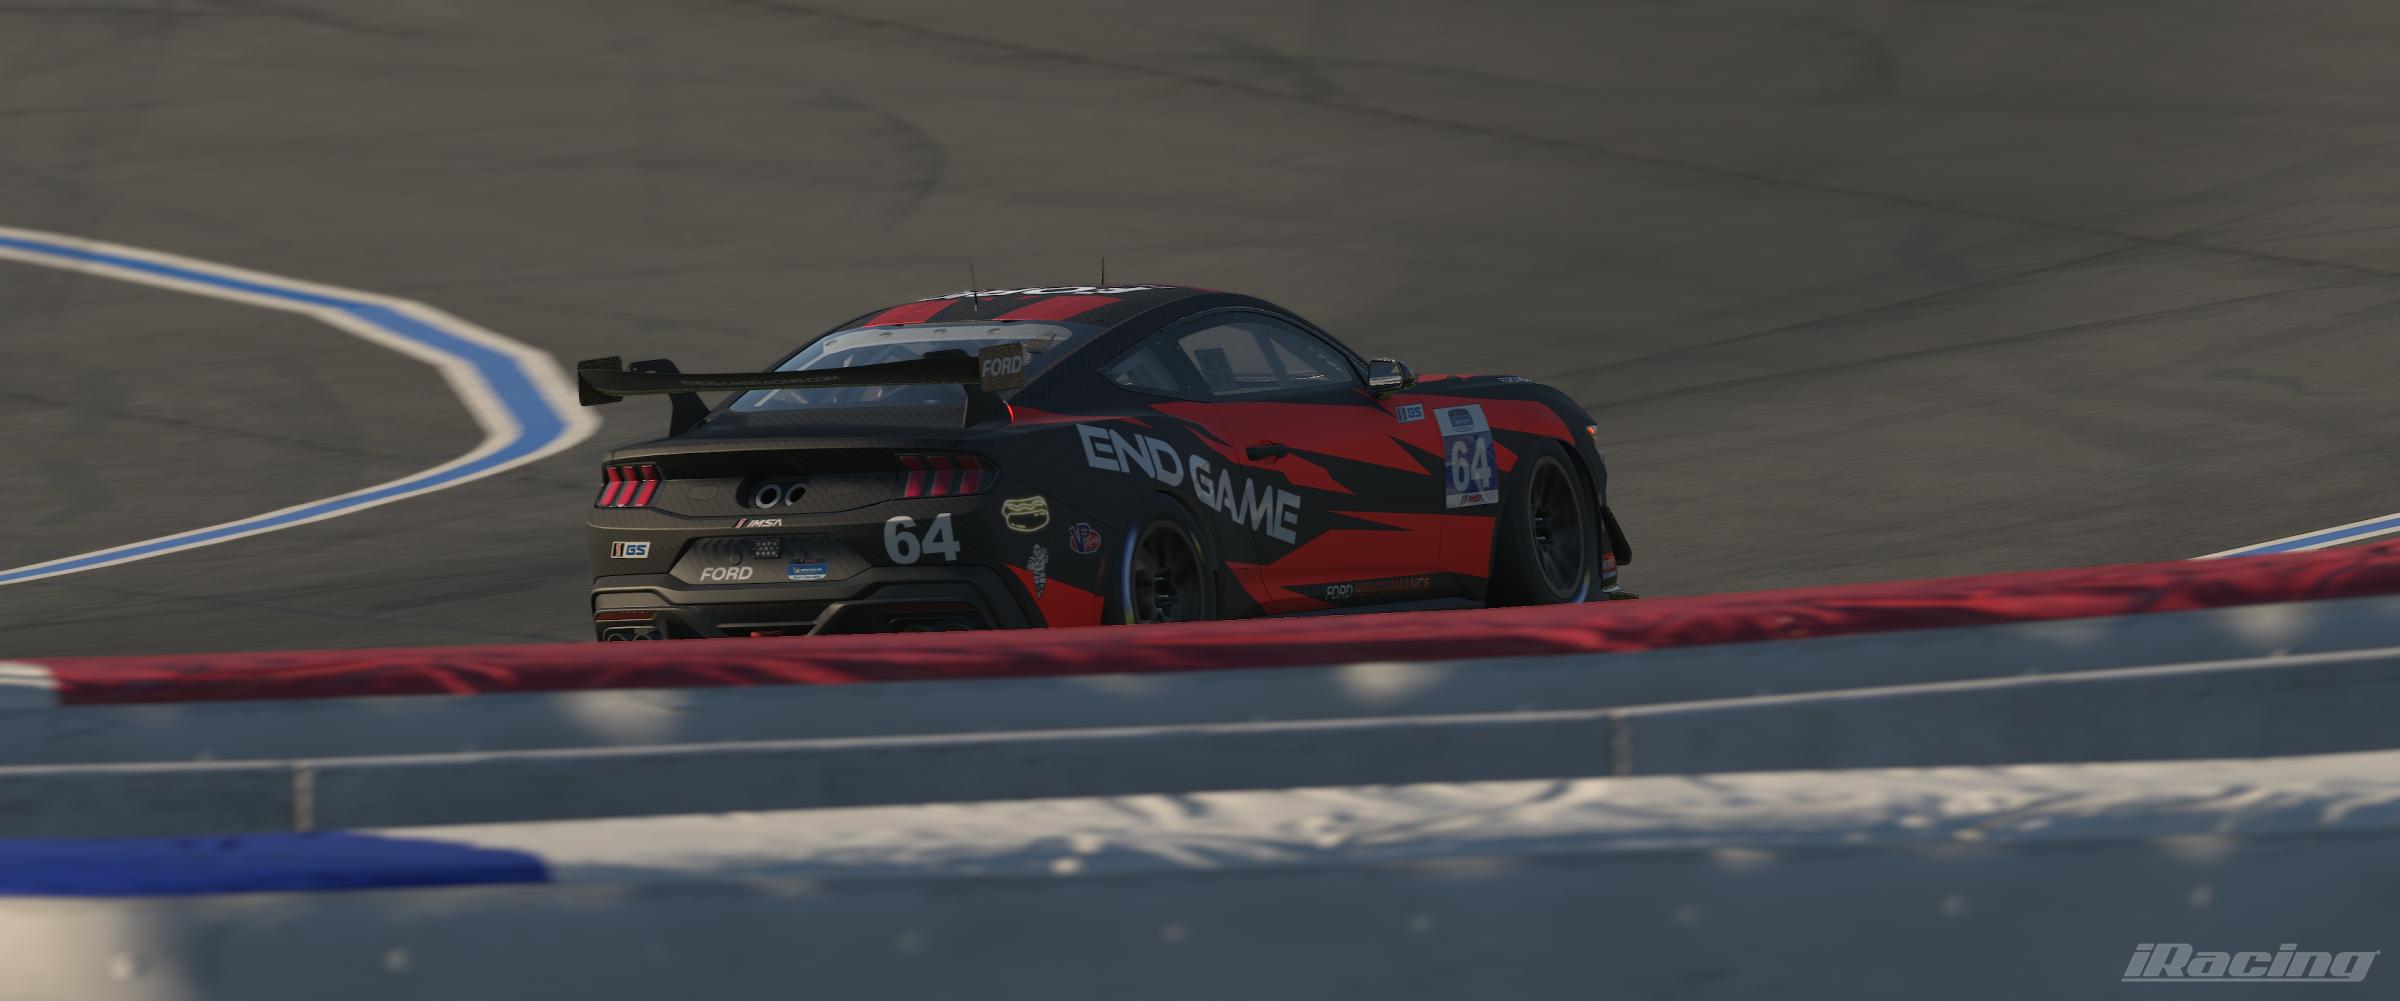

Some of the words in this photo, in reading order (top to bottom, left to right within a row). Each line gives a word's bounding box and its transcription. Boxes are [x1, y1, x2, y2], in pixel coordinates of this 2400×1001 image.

[982, 355, 1022, 377] FORD
[1407, 407, 1422, 419] GS
[1452, 437, 1492, 491] 64
[1076, 423, 1184, 487] END
[1189, 454, 1301, 545] GAME
[747, 518, 783, 528] IMSA
[884, 512, 960, 565] 64
[625, 544, 648, 556] GS
[700, 566, 754, 582] FORD
[1325, 583, 1354, 600] FORD
